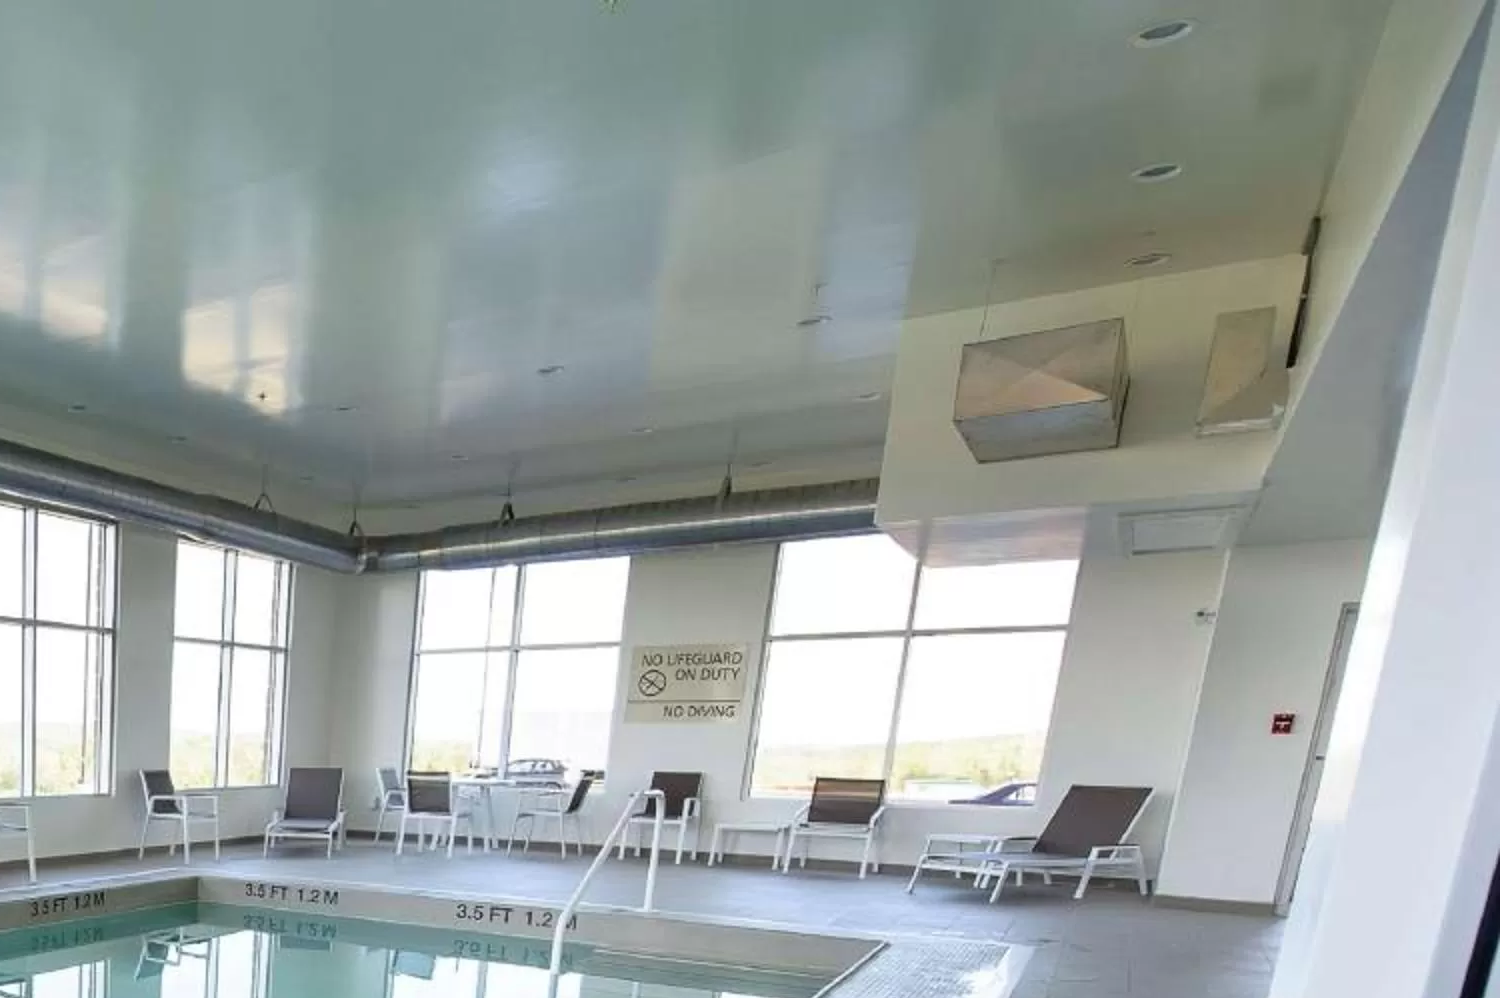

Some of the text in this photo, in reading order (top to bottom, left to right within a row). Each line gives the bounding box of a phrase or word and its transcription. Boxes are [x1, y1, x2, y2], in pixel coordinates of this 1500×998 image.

[642, 651, 743, 667] NO LIFEGUARD
[675, 667, 741, 681] ON DUTY
[663, 704, 736, 718] NO DIVING
[245, 882, 339, 905] 3.5 FT 1.2 M
[31, 891, 105, 917] 35 FT 12 M
[456, 903, 484, 921] 3.5
[489, 907, 514, 924] FT
[525, 911, 552, 929] 1.2
